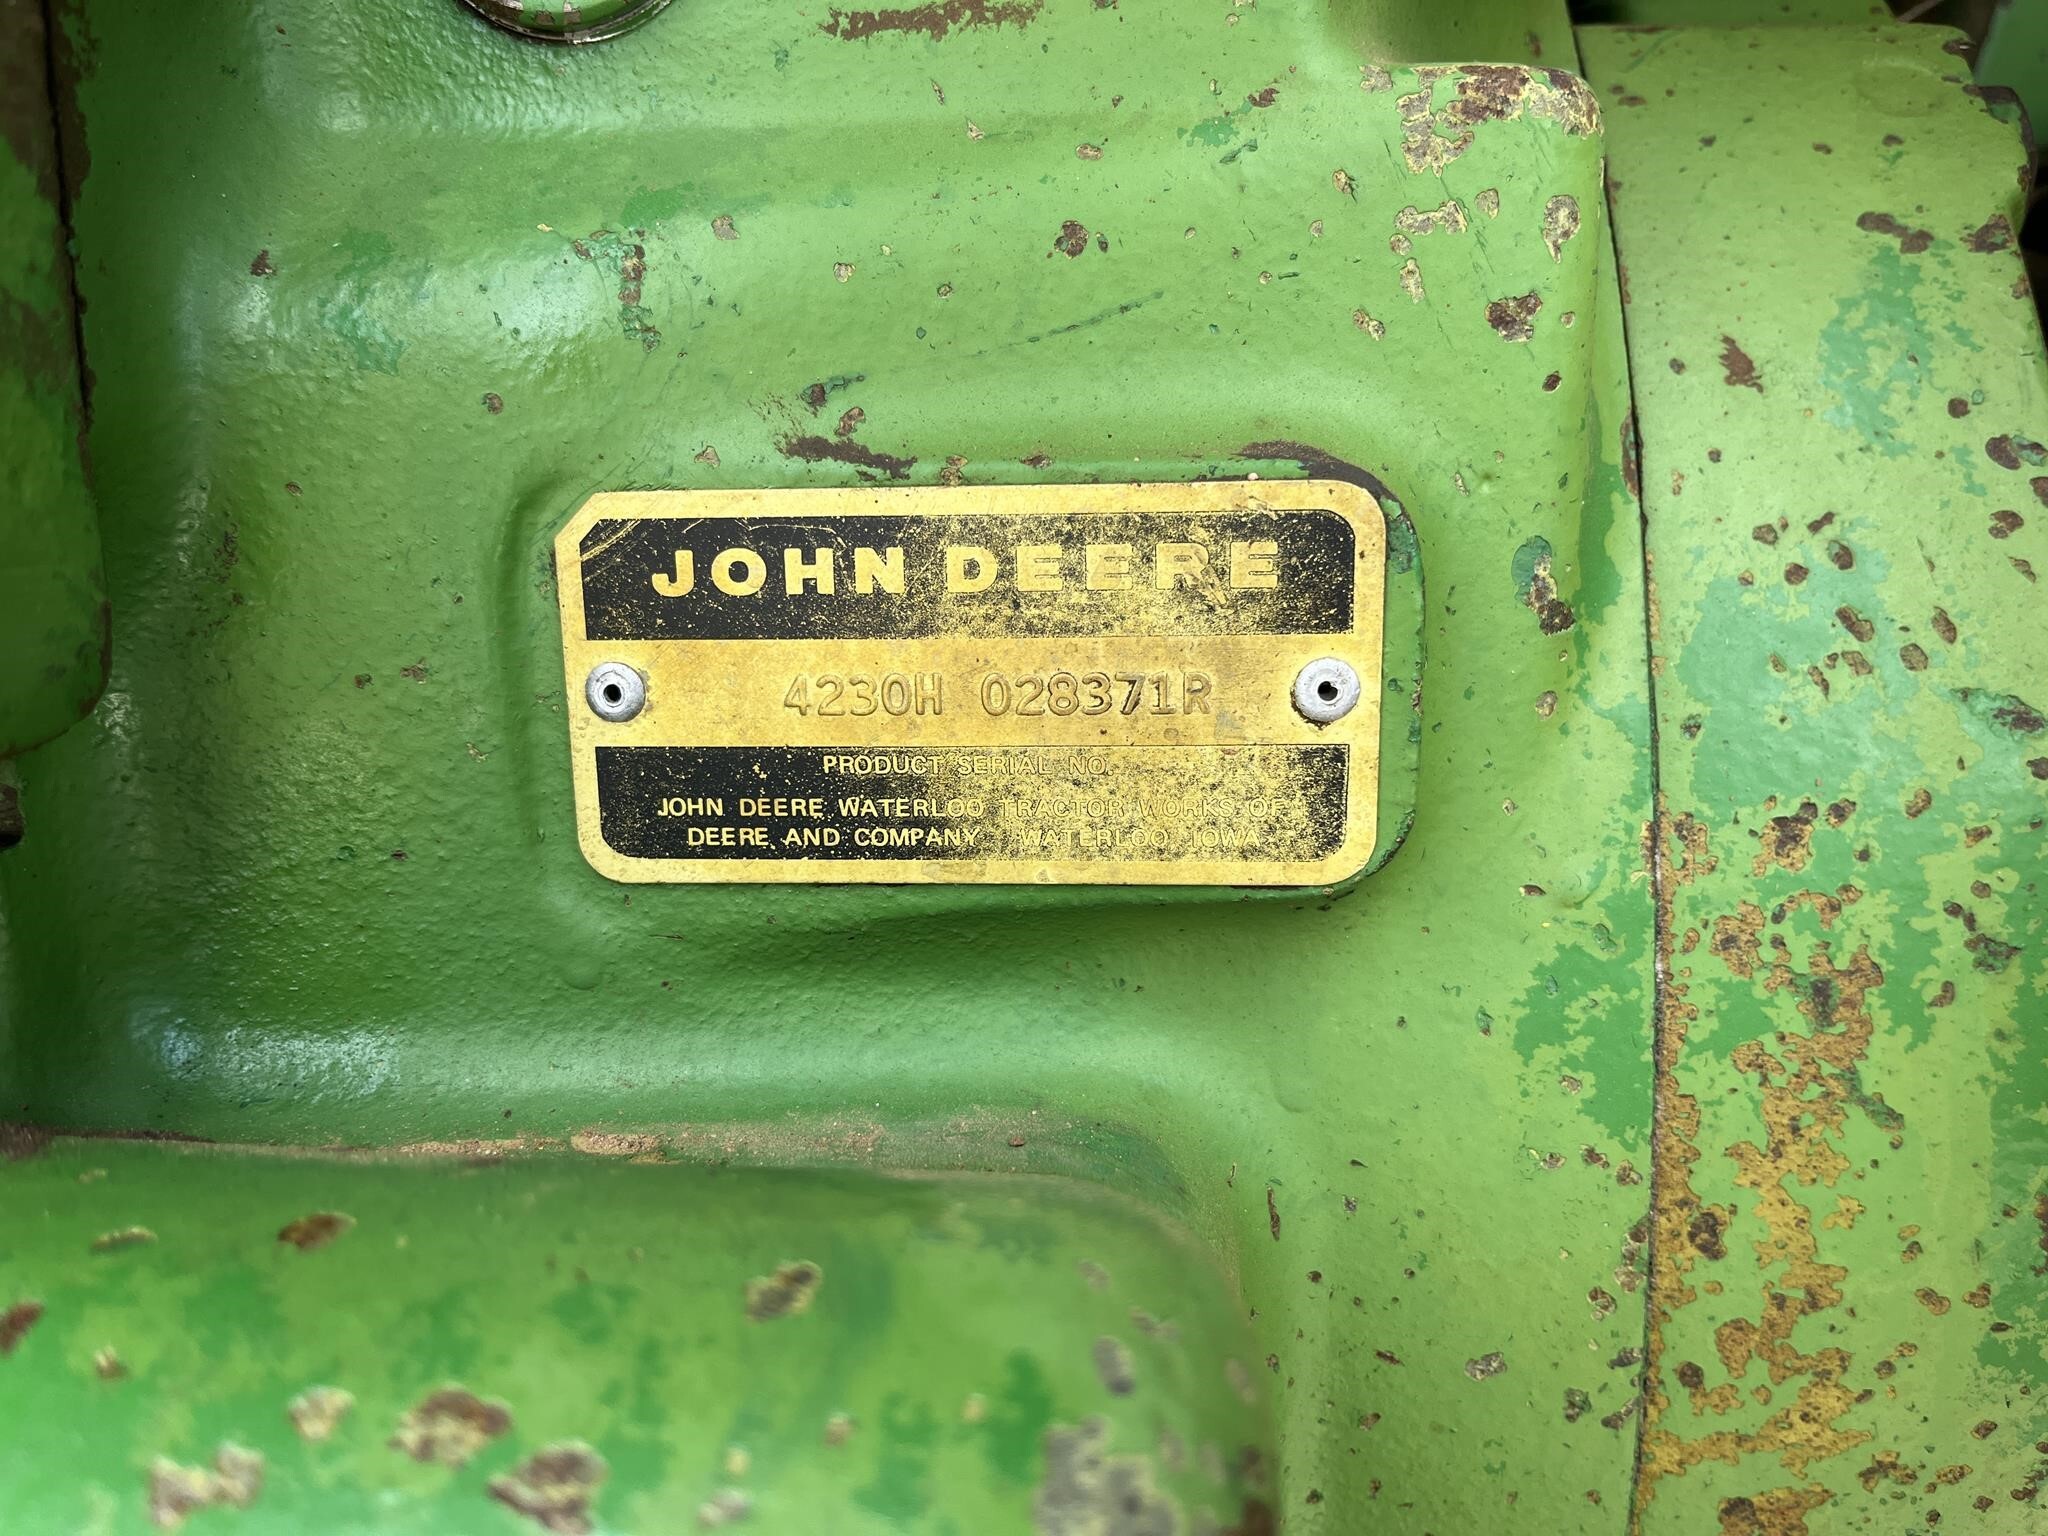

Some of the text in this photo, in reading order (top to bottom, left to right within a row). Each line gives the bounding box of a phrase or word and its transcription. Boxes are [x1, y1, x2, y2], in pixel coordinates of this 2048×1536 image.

[651, 541, 1279, 597] JOHN DEERE
[783, 671, 1213, 717] 4230H 028371R
[823, 755, 1114, 776] PRODUCT SERIAL NO.
[657, 797, 1286, 818] JOHN DEERE WATERLOO TRACTOR WORKS OF
[687, 827, 769, 846] DEERE
[785, 827, 841, 847] AND
[854, 827, 981, 847] COMPANY
[1192, 827, 1262, 848] IOWA
